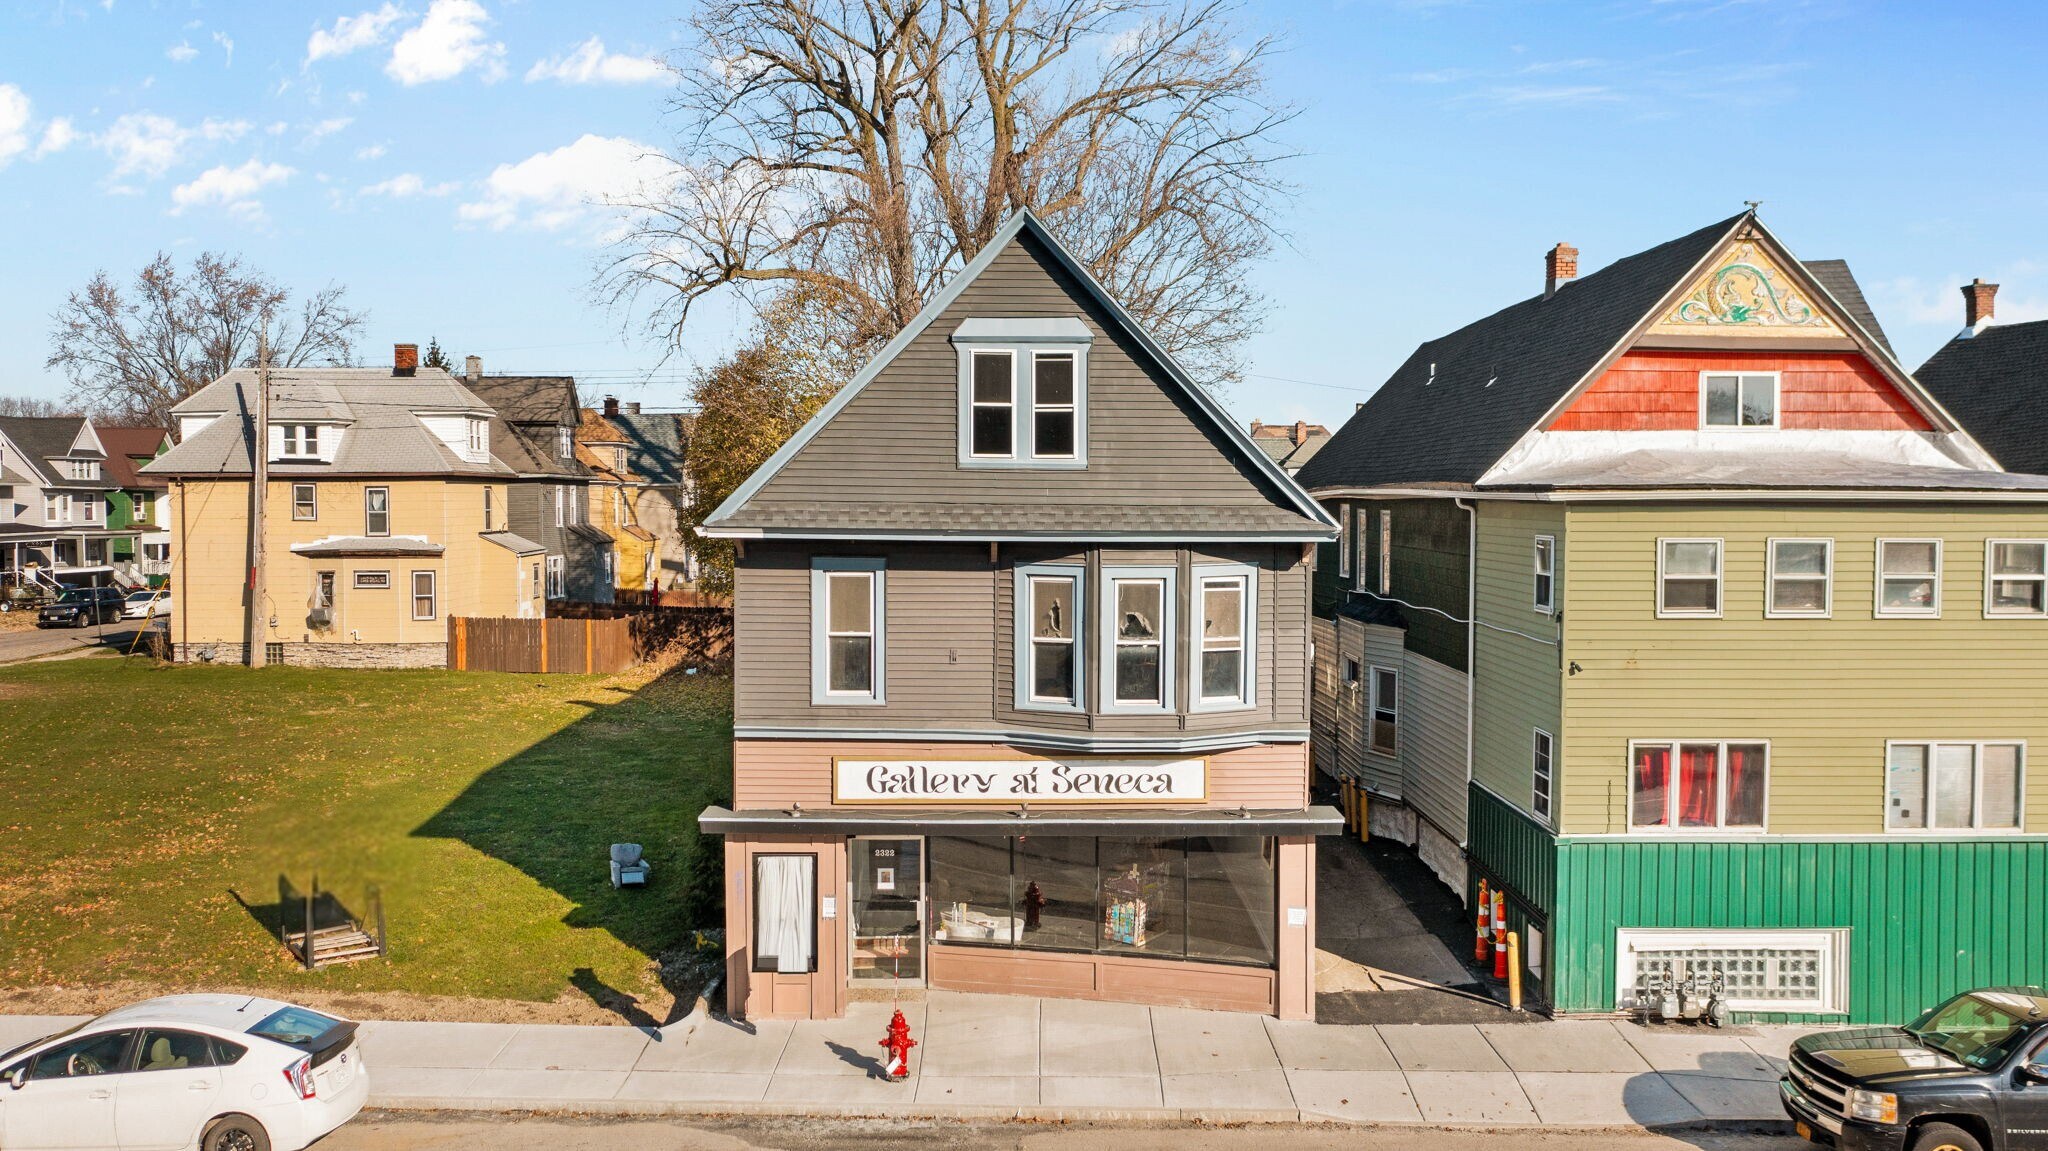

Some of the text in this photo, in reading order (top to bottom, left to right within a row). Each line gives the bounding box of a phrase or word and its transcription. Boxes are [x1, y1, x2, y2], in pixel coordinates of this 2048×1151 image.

[866, 765, 1174, 795] Gallery at Seneca
[875, 849, 895, 857] 2322
